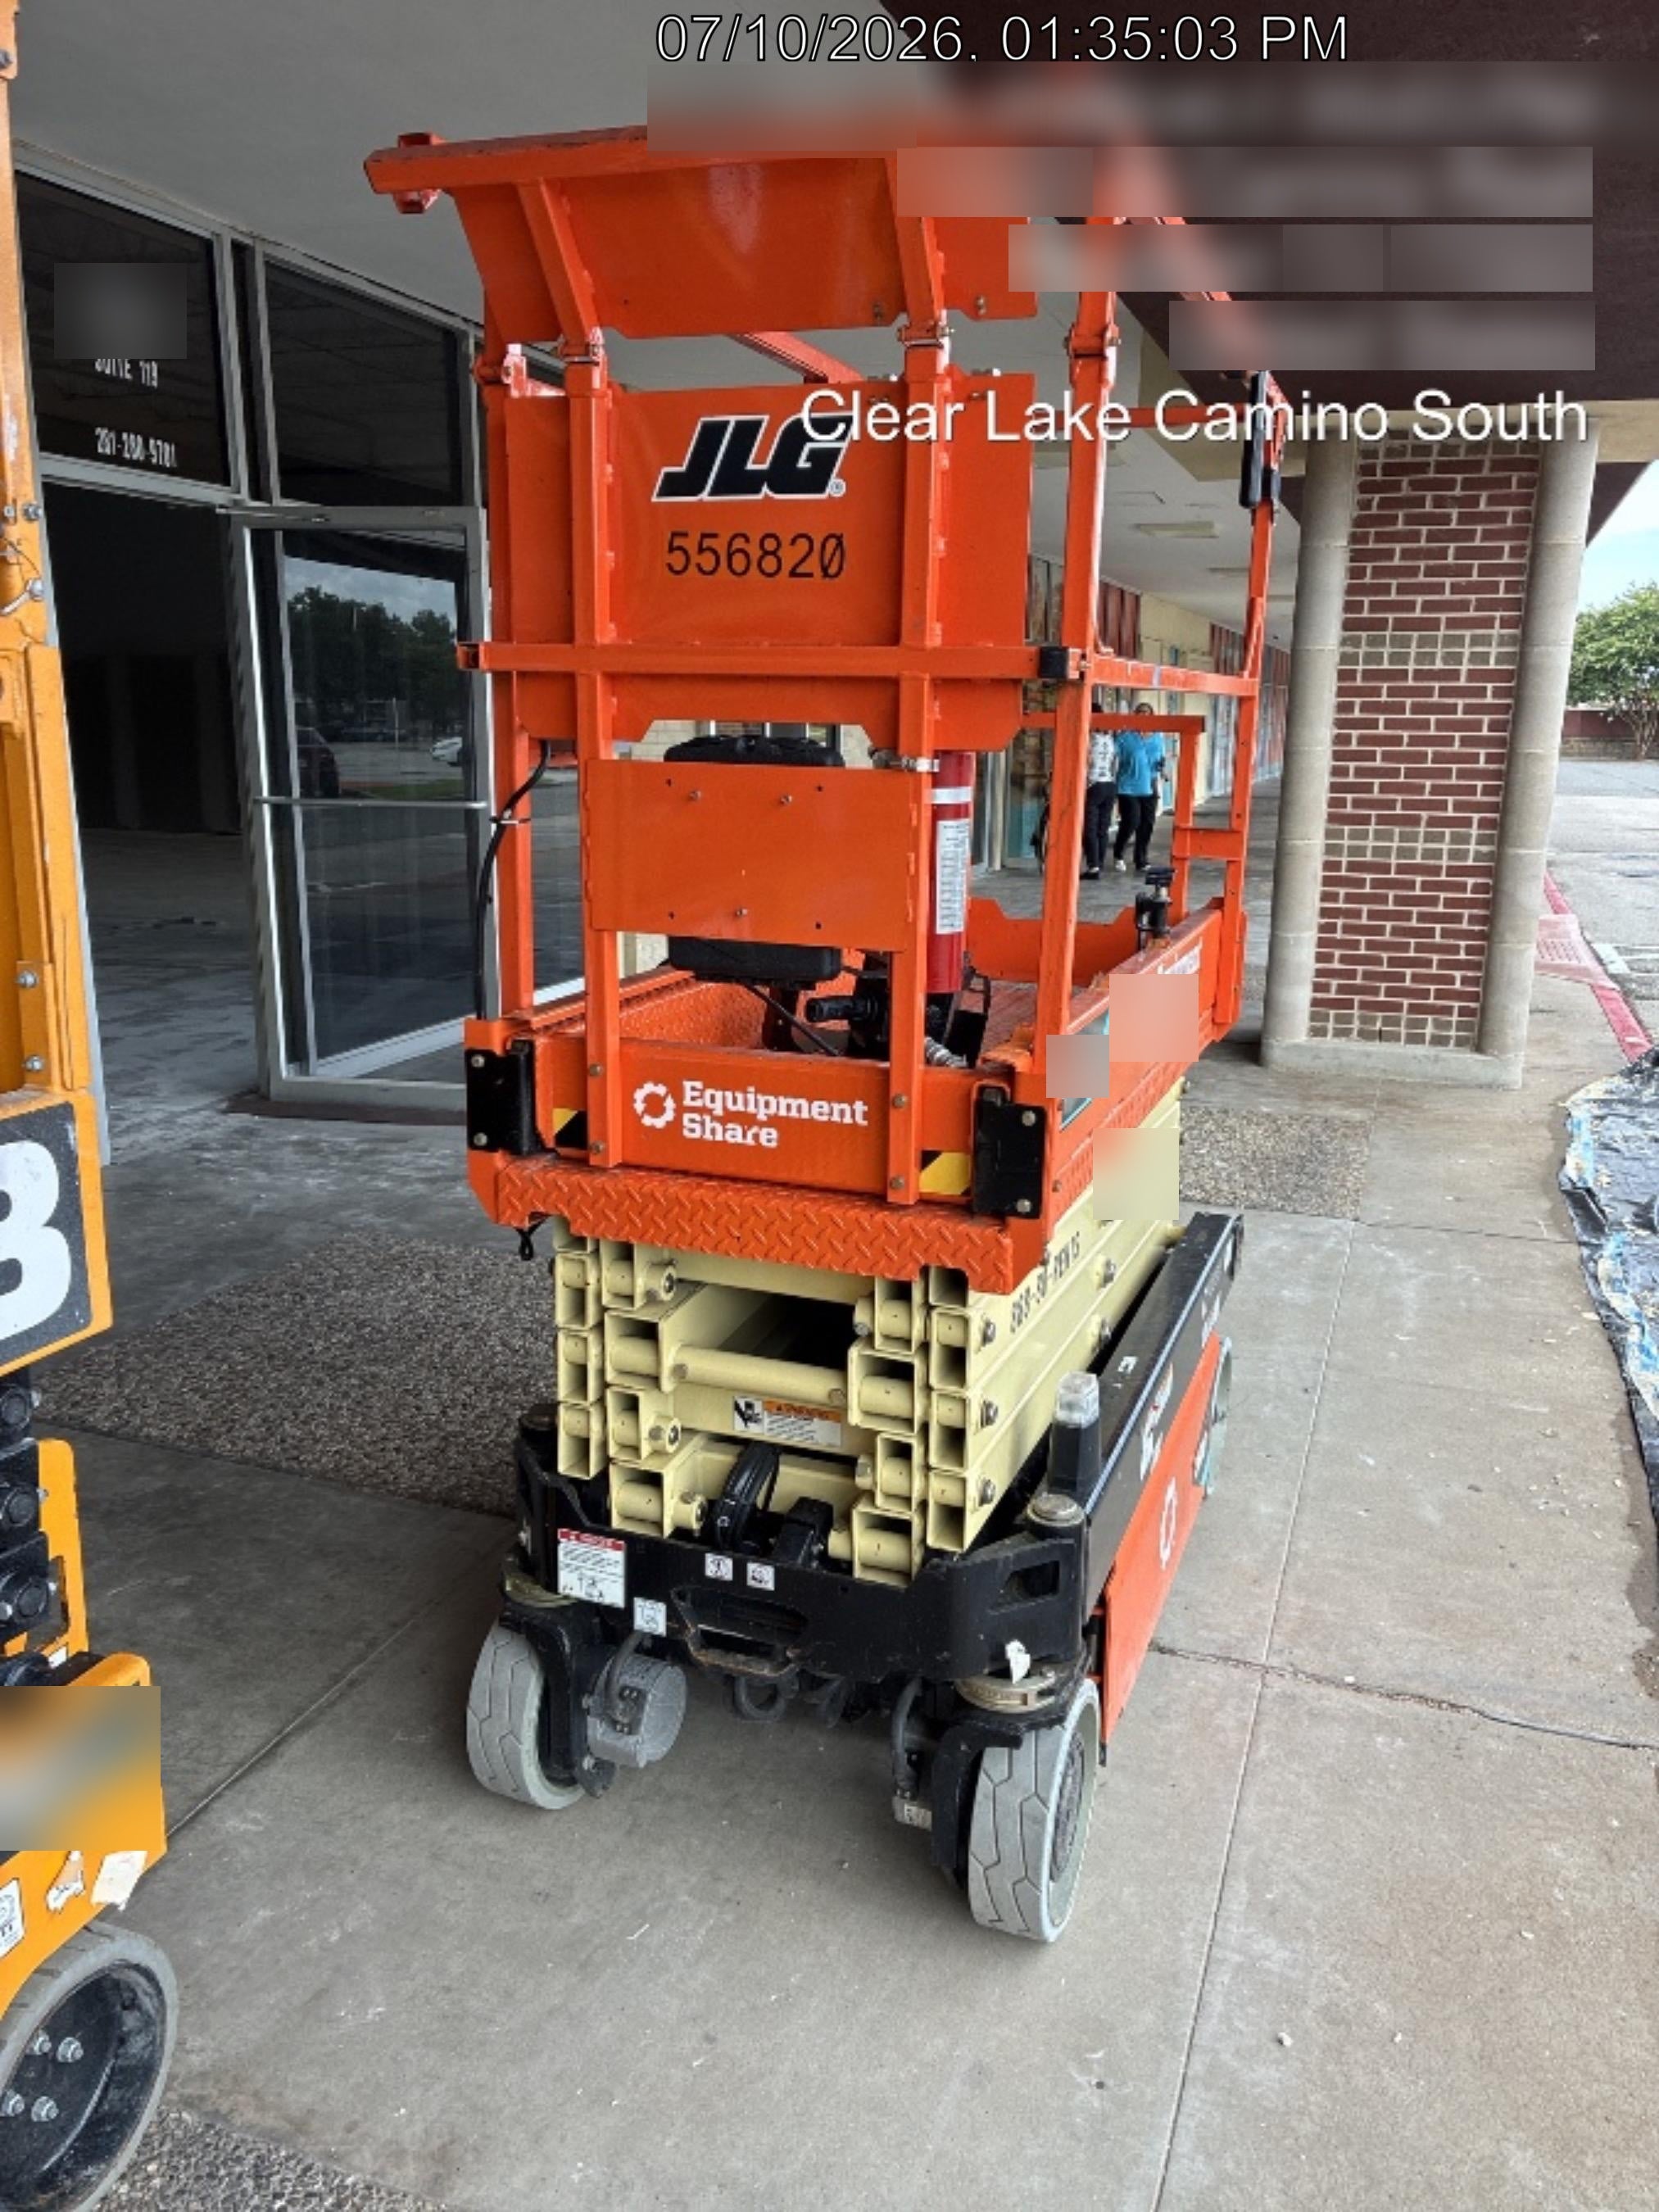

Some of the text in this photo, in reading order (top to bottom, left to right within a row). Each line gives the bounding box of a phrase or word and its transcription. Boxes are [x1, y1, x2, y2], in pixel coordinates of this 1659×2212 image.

[651, 412, 854, 501] JLG
[664, 531, 846, 579] 556820
[682, 1080, 868, 1126] Equipment
[682, 1113, 778, 1148] Share
